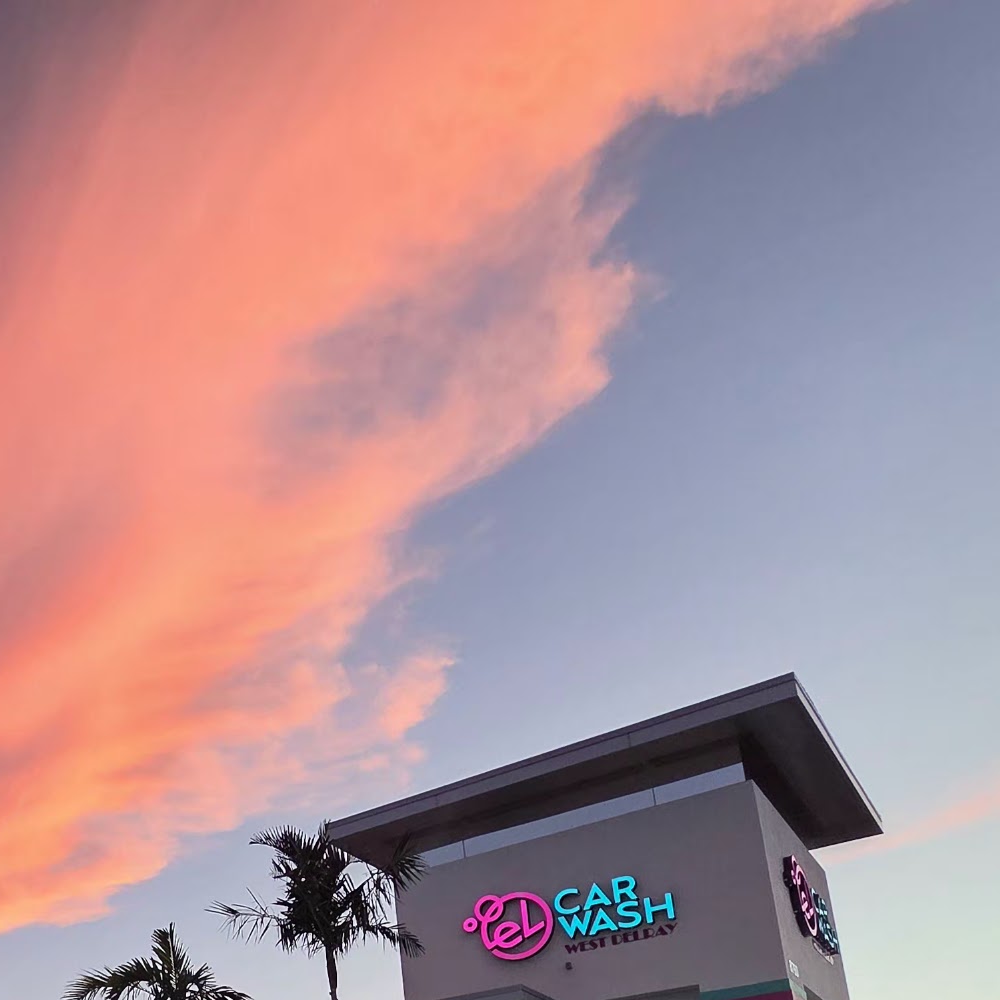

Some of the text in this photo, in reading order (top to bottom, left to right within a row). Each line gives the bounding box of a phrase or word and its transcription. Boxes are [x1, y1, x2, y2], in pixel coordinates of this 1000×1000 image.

[554, 875, 637, 915] CAR
[558, 892, 676, 939] WASH
[564, 922, 678, 955] WEST DELRAY
